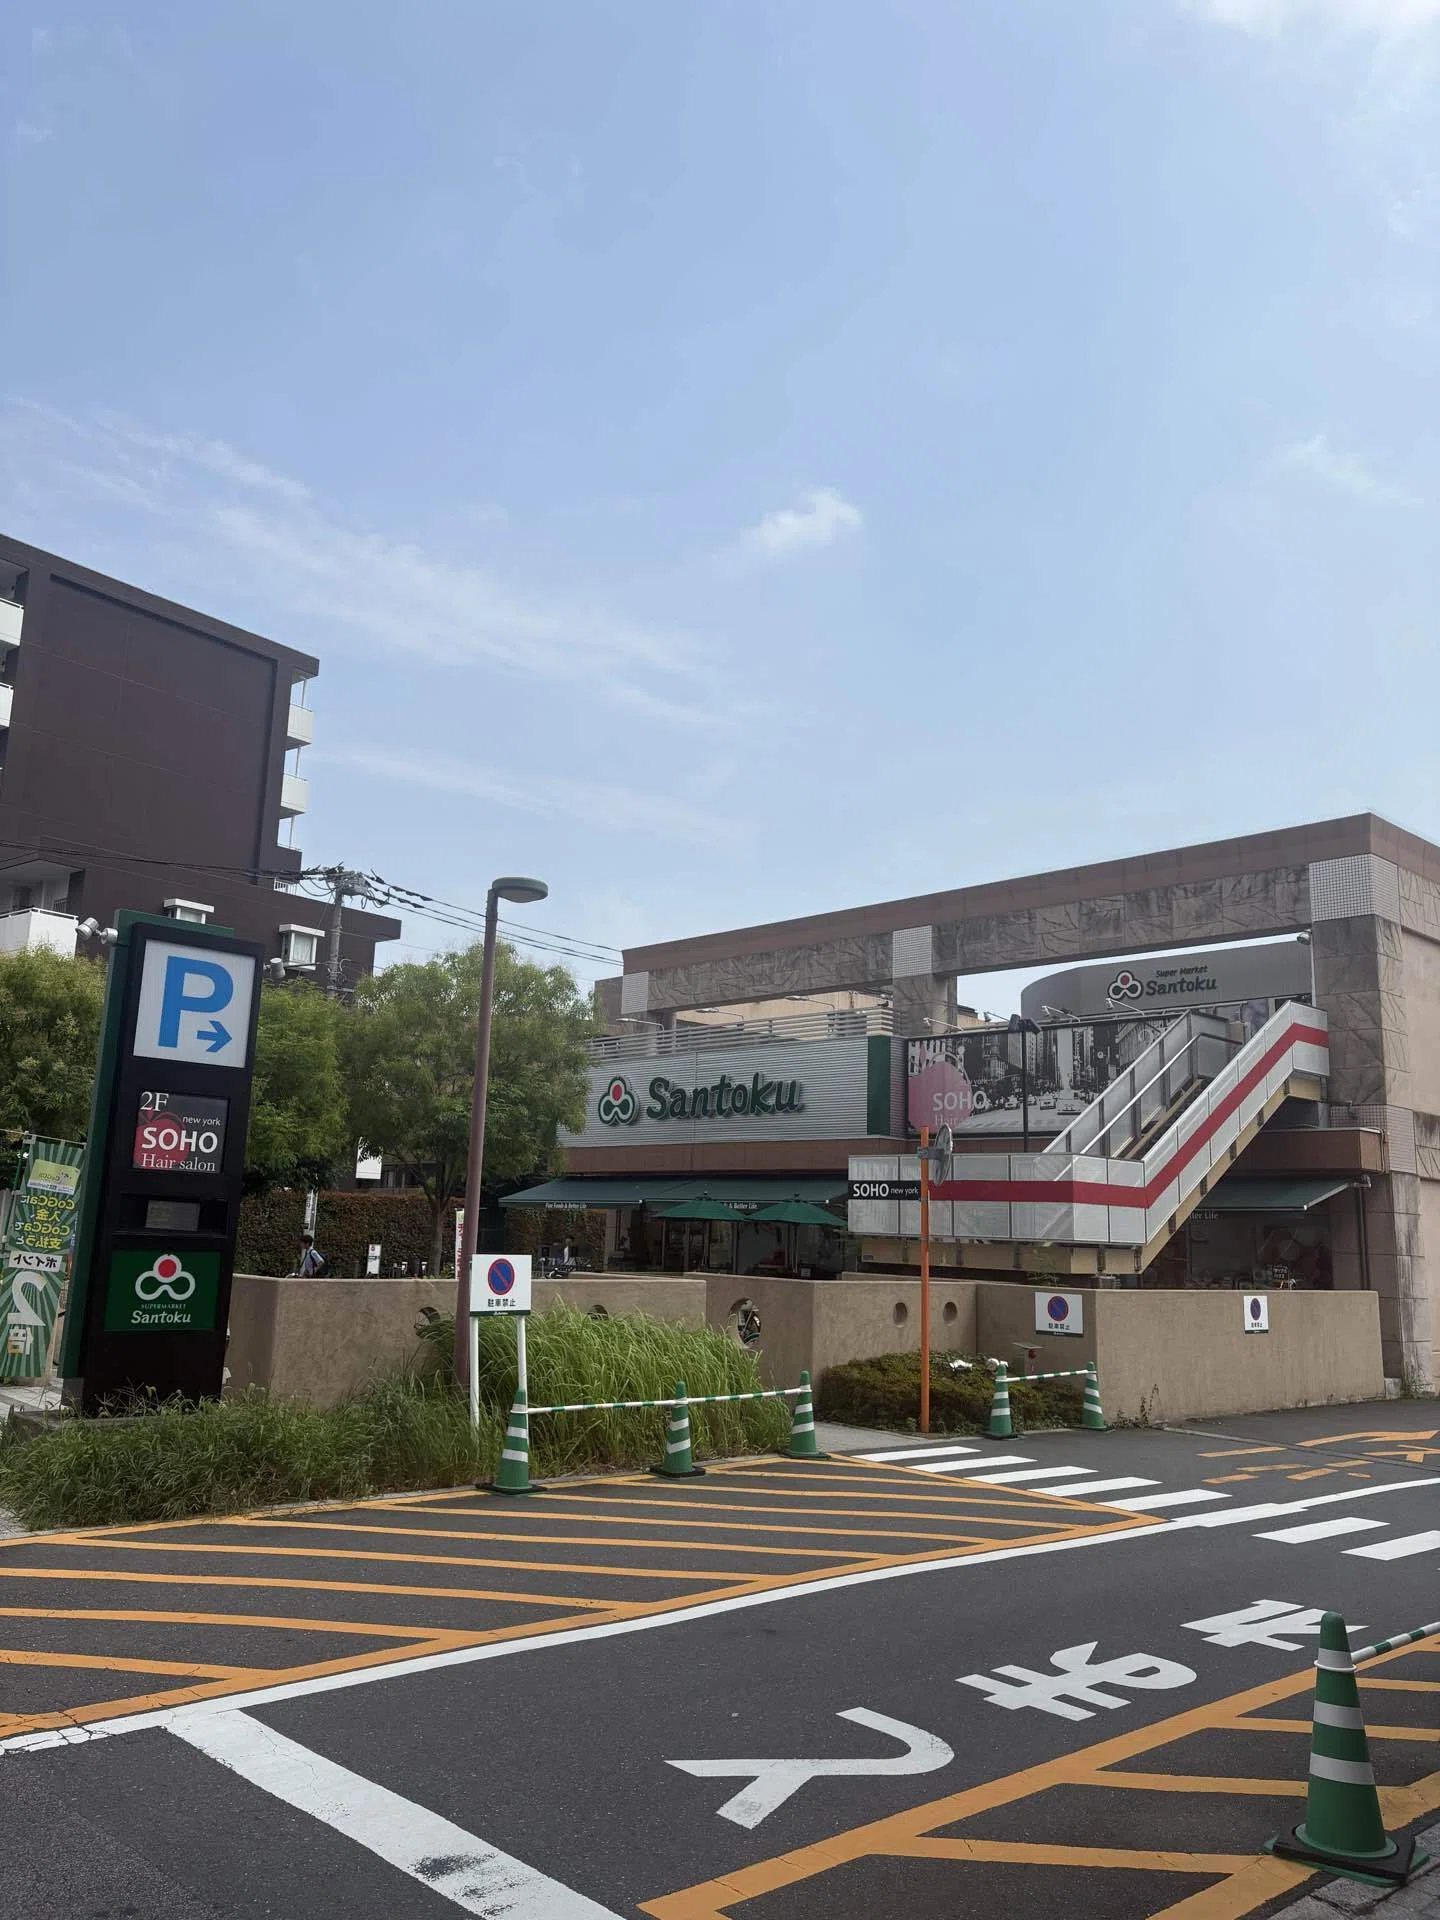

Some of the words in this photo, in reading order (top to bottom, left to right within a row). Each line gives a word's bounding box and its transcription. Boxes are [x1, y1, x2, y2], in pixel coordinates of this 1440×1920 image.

[1156, 968, 1178, 978] Super
[1180, 965, 1208, 975] Market
[1146, 976, 1217, 996] Santoku
[158, 955, 234, 1048] P
[140, 1091, 170, 1112] 2F
[647, 1072, 803, 1120] Santoku
[932, 1090, 987, 1112] SOHO
[182, 1115, 201, 1124] new
[202, 1117, 221, 1127] york
[141, 1127, 218, 1154] SOHO
[141, 1153, 177, 1169] Hair
[179, 1156, 216, 1171] salon
[852, 1183, 890, 1197] SOHO
[904, 1186, 919, 1195] york
[487, 1298, 517, 1308] 駐車禁止
[131, 1310, 192, 1324] Santoku
